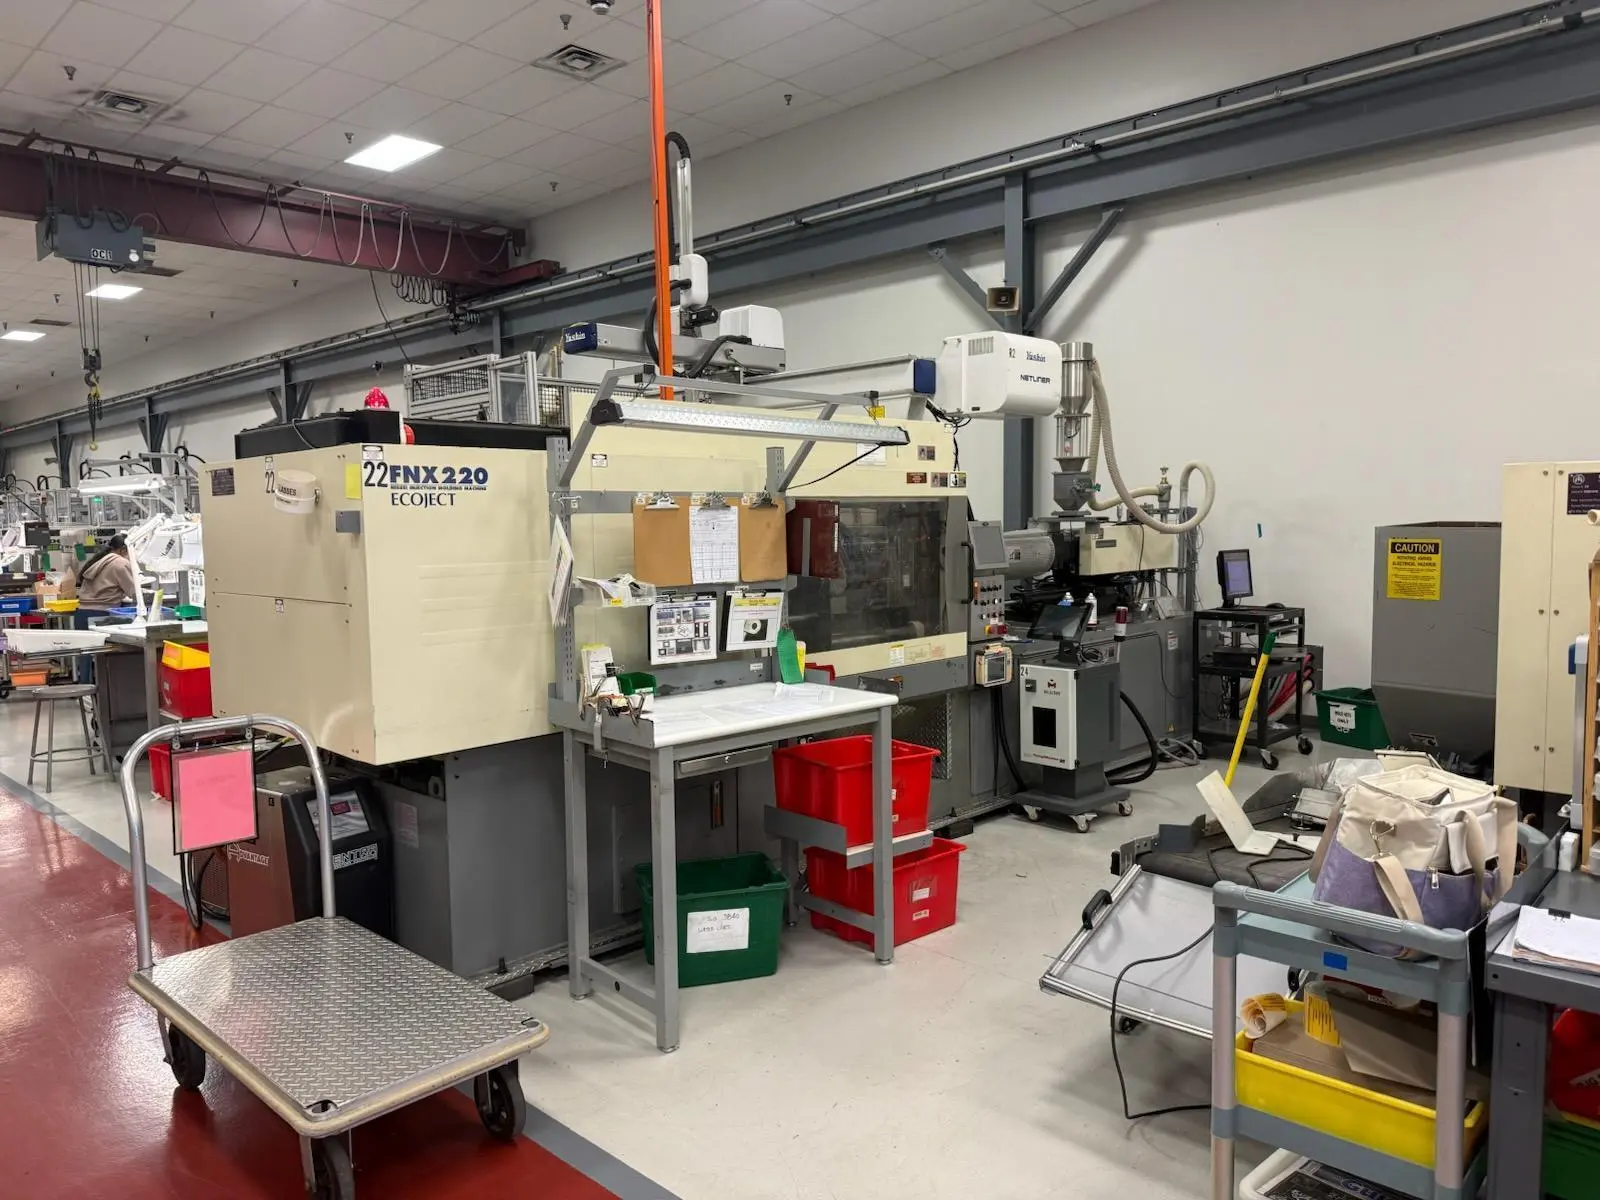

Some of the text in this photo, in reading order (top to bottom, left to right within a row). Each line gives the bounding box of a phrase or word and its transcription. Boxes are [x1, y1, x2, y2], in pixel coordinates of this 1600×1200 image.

[364, 461, 388, 487] 22
[265, 471, 275, 494] 22
[391, 492, 456, 508] ECOJECT
[1394, 543, 1435, 553] CAUTION
[1020, 666, 1029, 677] 24
